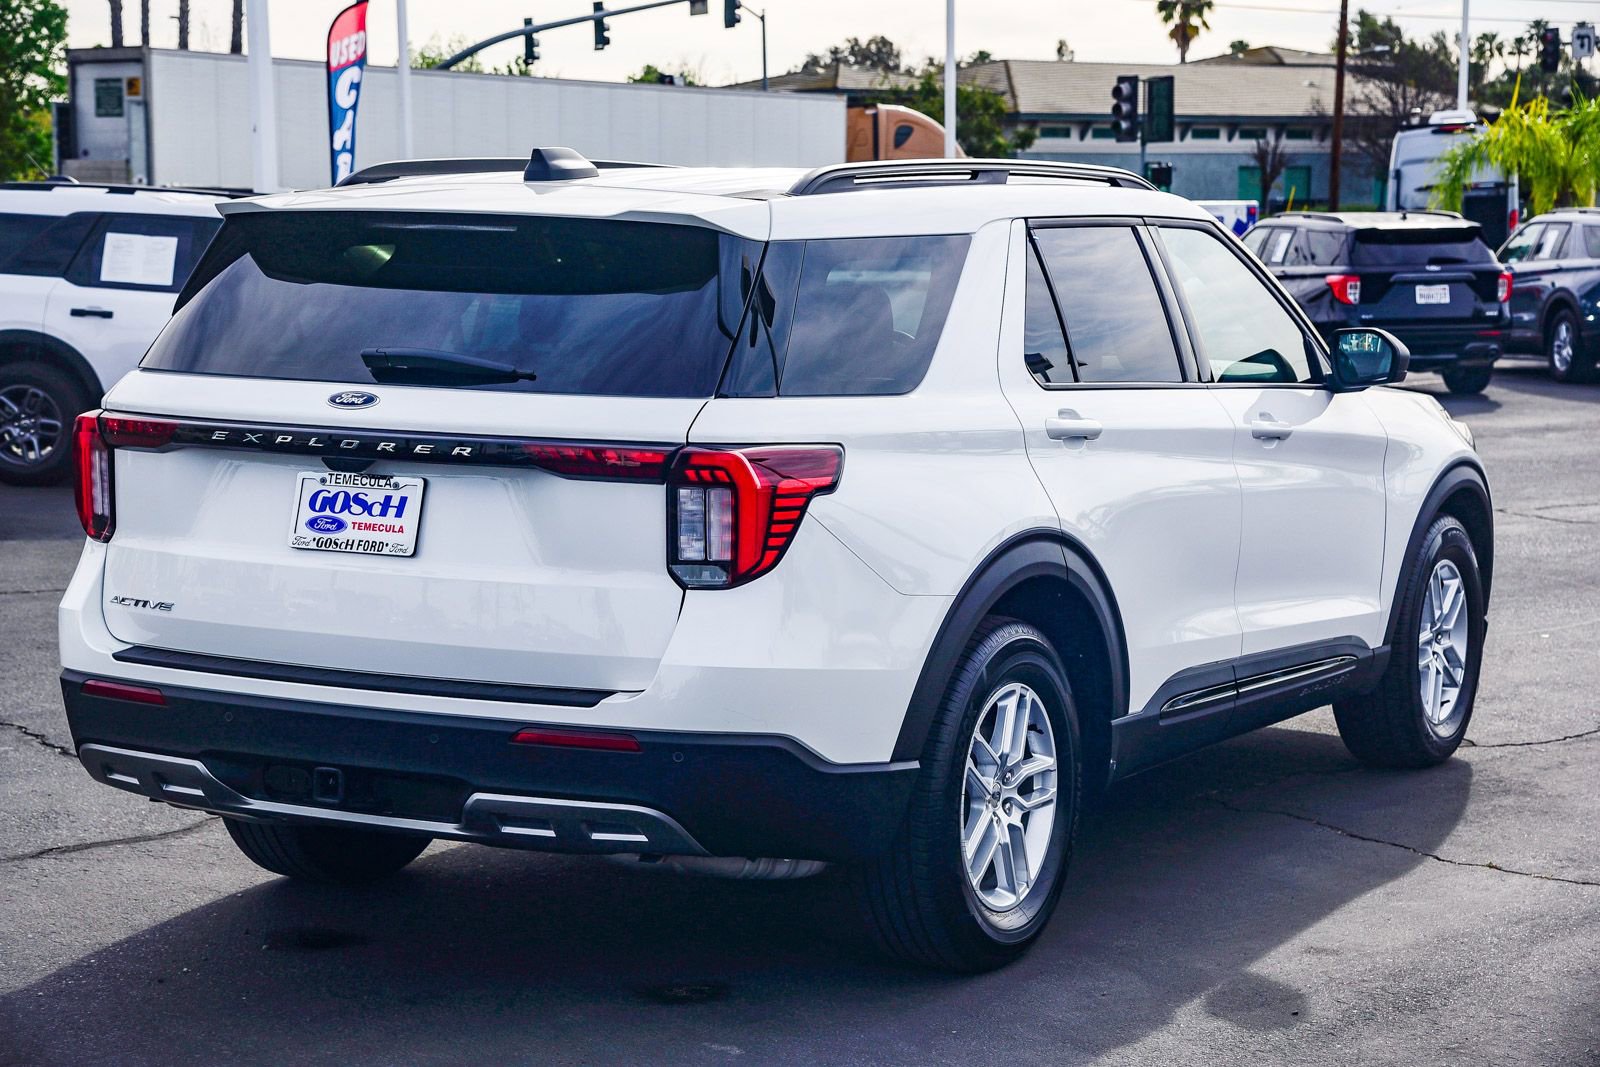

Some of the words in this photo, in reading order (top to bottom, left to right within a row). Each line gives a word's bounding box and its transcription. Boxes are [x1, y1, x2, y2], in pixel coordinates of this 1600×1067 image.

[331, 30, 366, 67] USED
[336, 393, 367, 404] Ford
[211, 431, 472, 456] EXPLORER
[328, 473, 392, 488] TEMECULA
[314, 518, 338, 530] Ford
[351, 521, 405, 534] TEMECULA
[110, 595, 174, 611] ACTIVE
